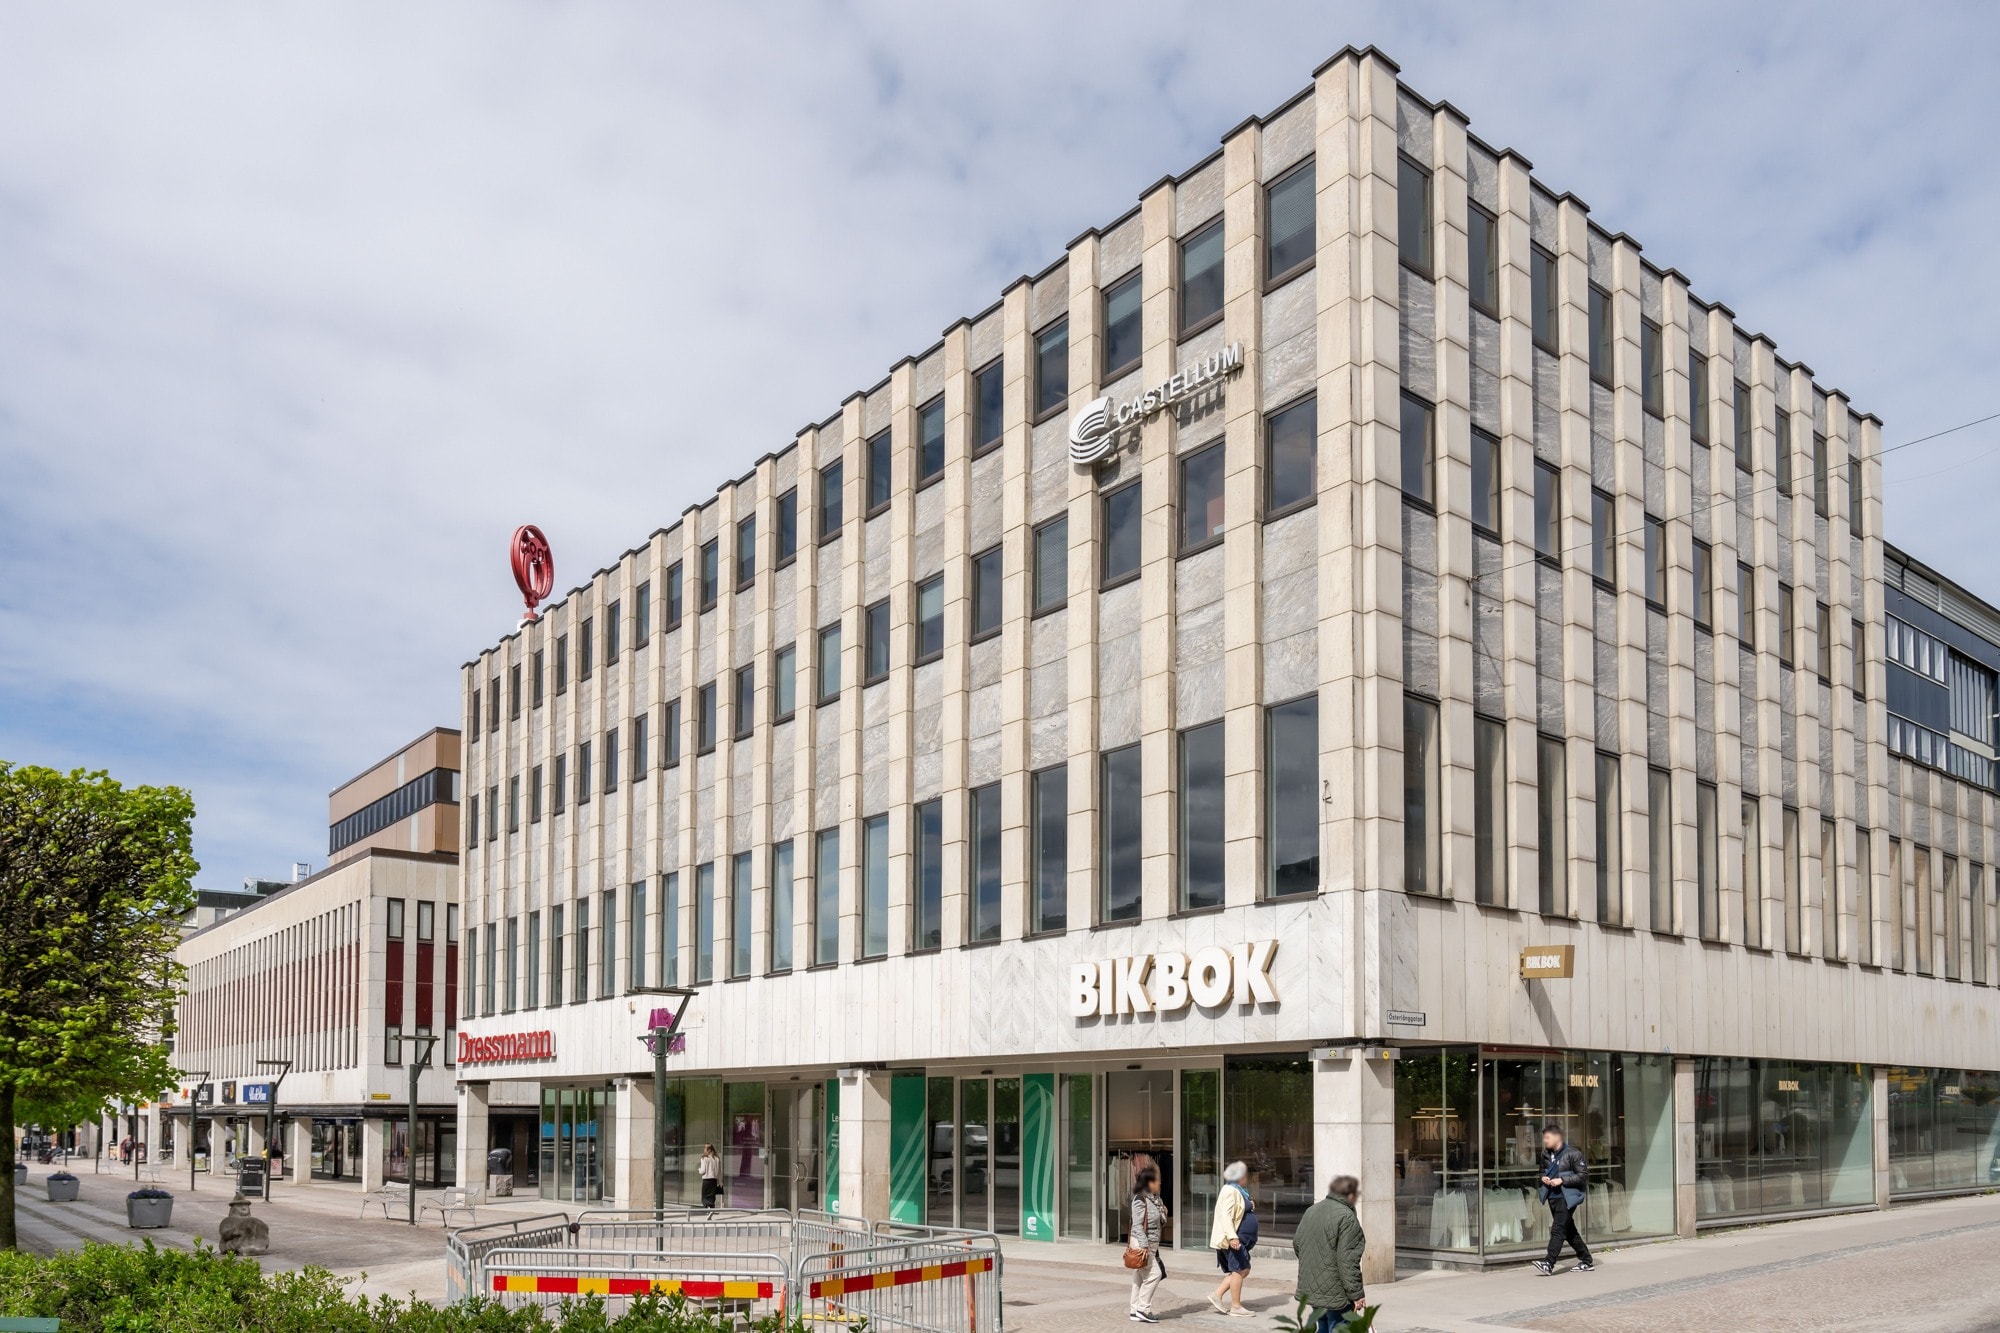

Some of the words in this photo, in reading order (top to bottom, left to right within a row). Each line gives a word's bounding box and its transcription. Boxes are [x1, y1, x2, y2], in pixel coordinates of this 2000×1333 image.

[1117, 341, 1244, 425] CASTELLUM
[1070, 939, 1281, 1017] BIKBOK
[1525, 954, 1561, 969] BIKBOK
[457, 1029, 552, 1063] Dressmann
